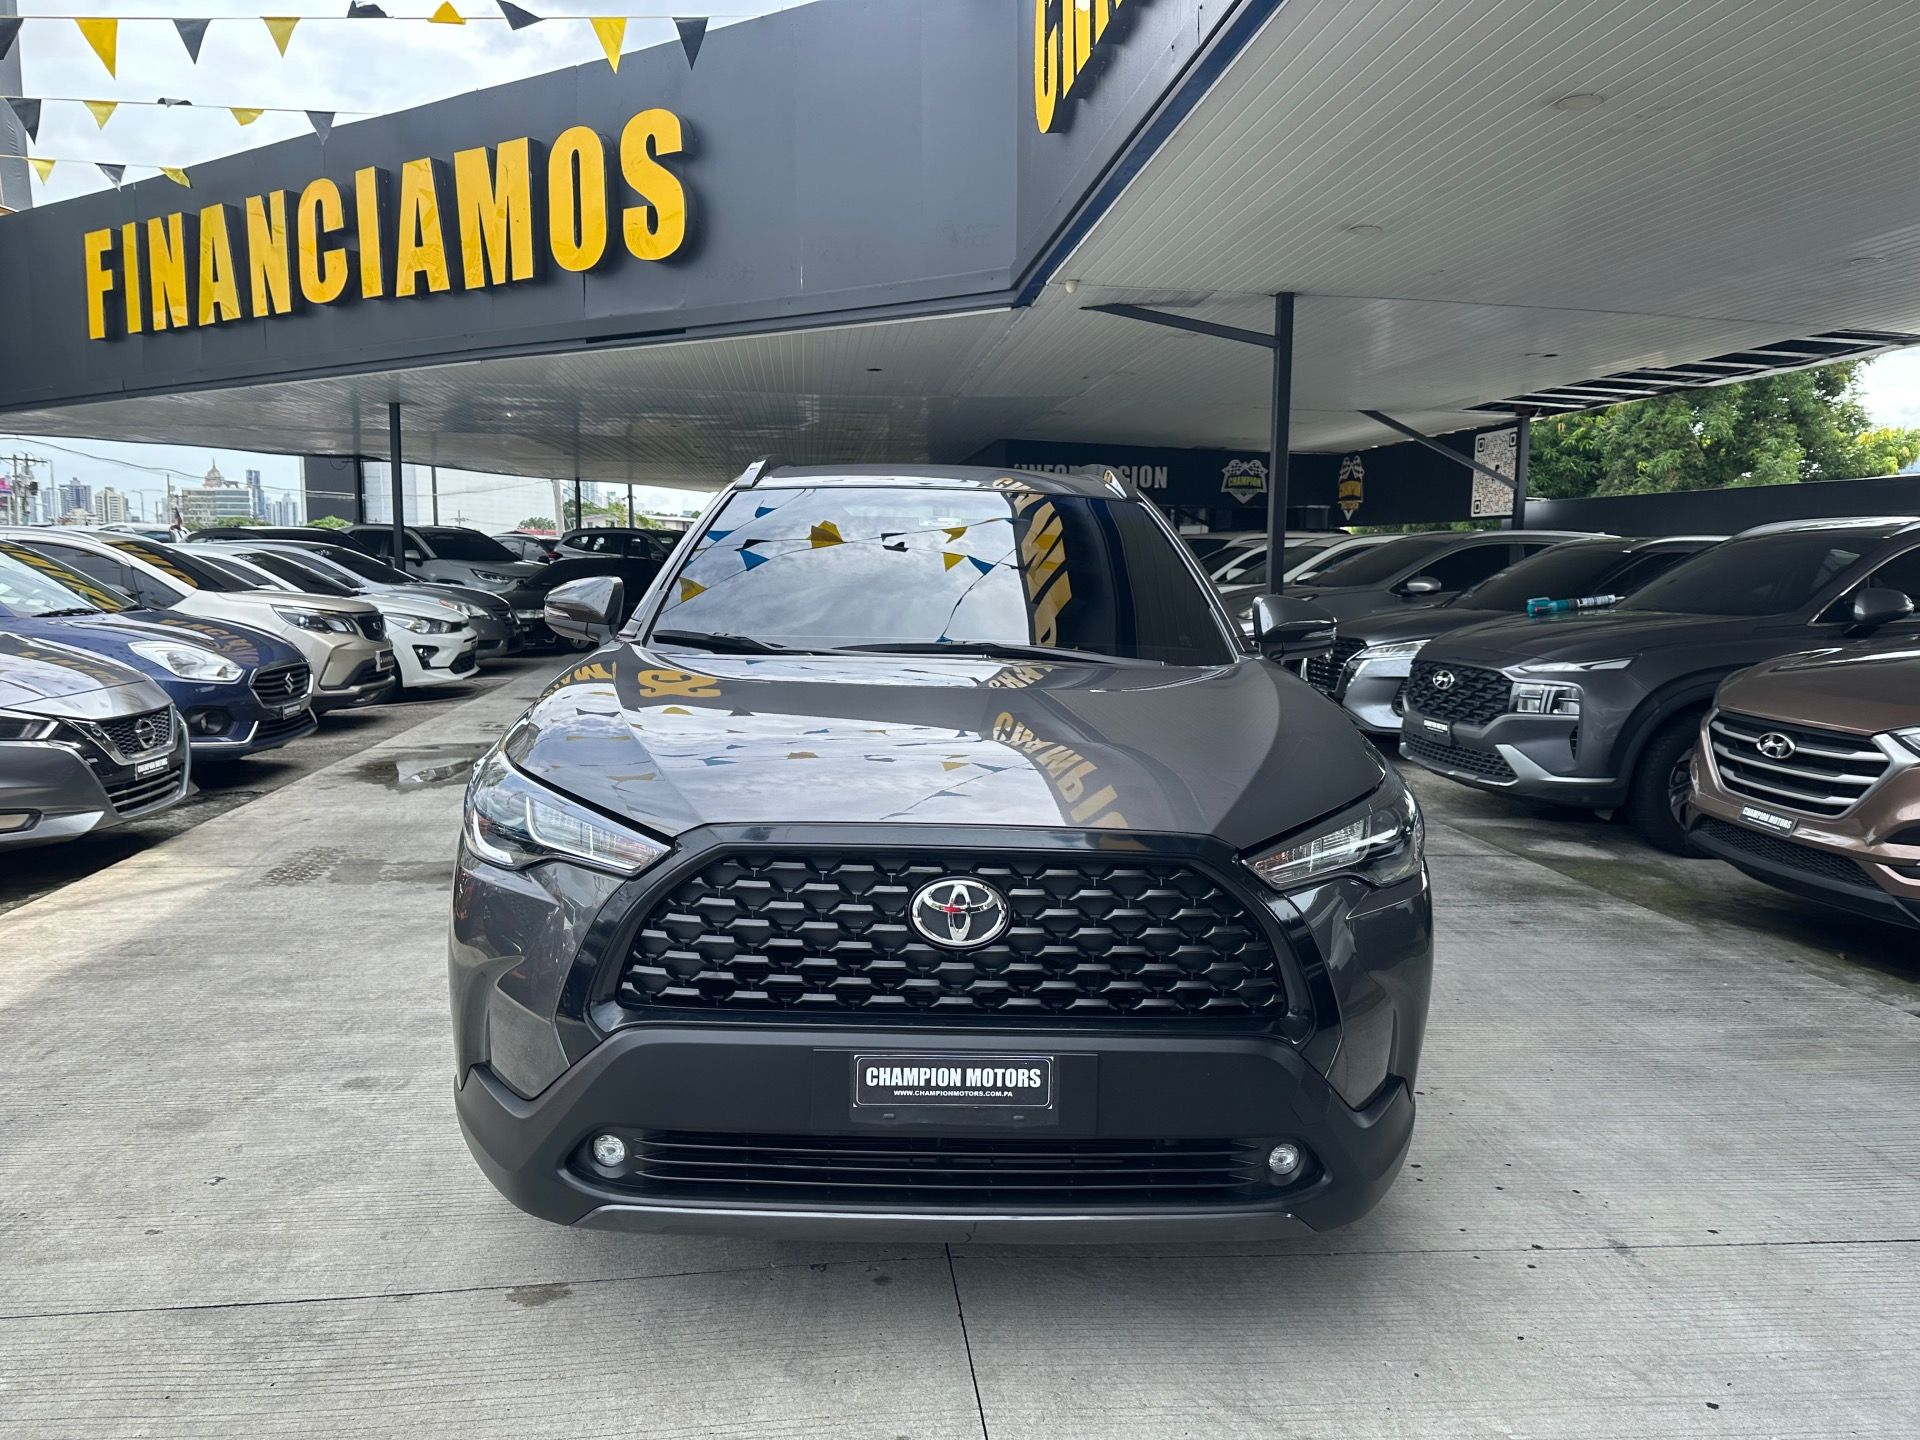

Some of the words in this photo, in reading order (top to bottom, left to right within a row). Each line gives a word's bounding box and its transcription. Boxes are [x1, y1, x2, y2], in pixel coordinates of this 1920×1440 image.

[84, 108, 686, 341] FINANCIAMOS
[865, 1066, 962, 1087] CHAMPION
[965, 1067, 1042, 1088] MOTORS
[893, 1089, 1013, 1097] WWW.CHAMPIONMOTORS.COM.PA
